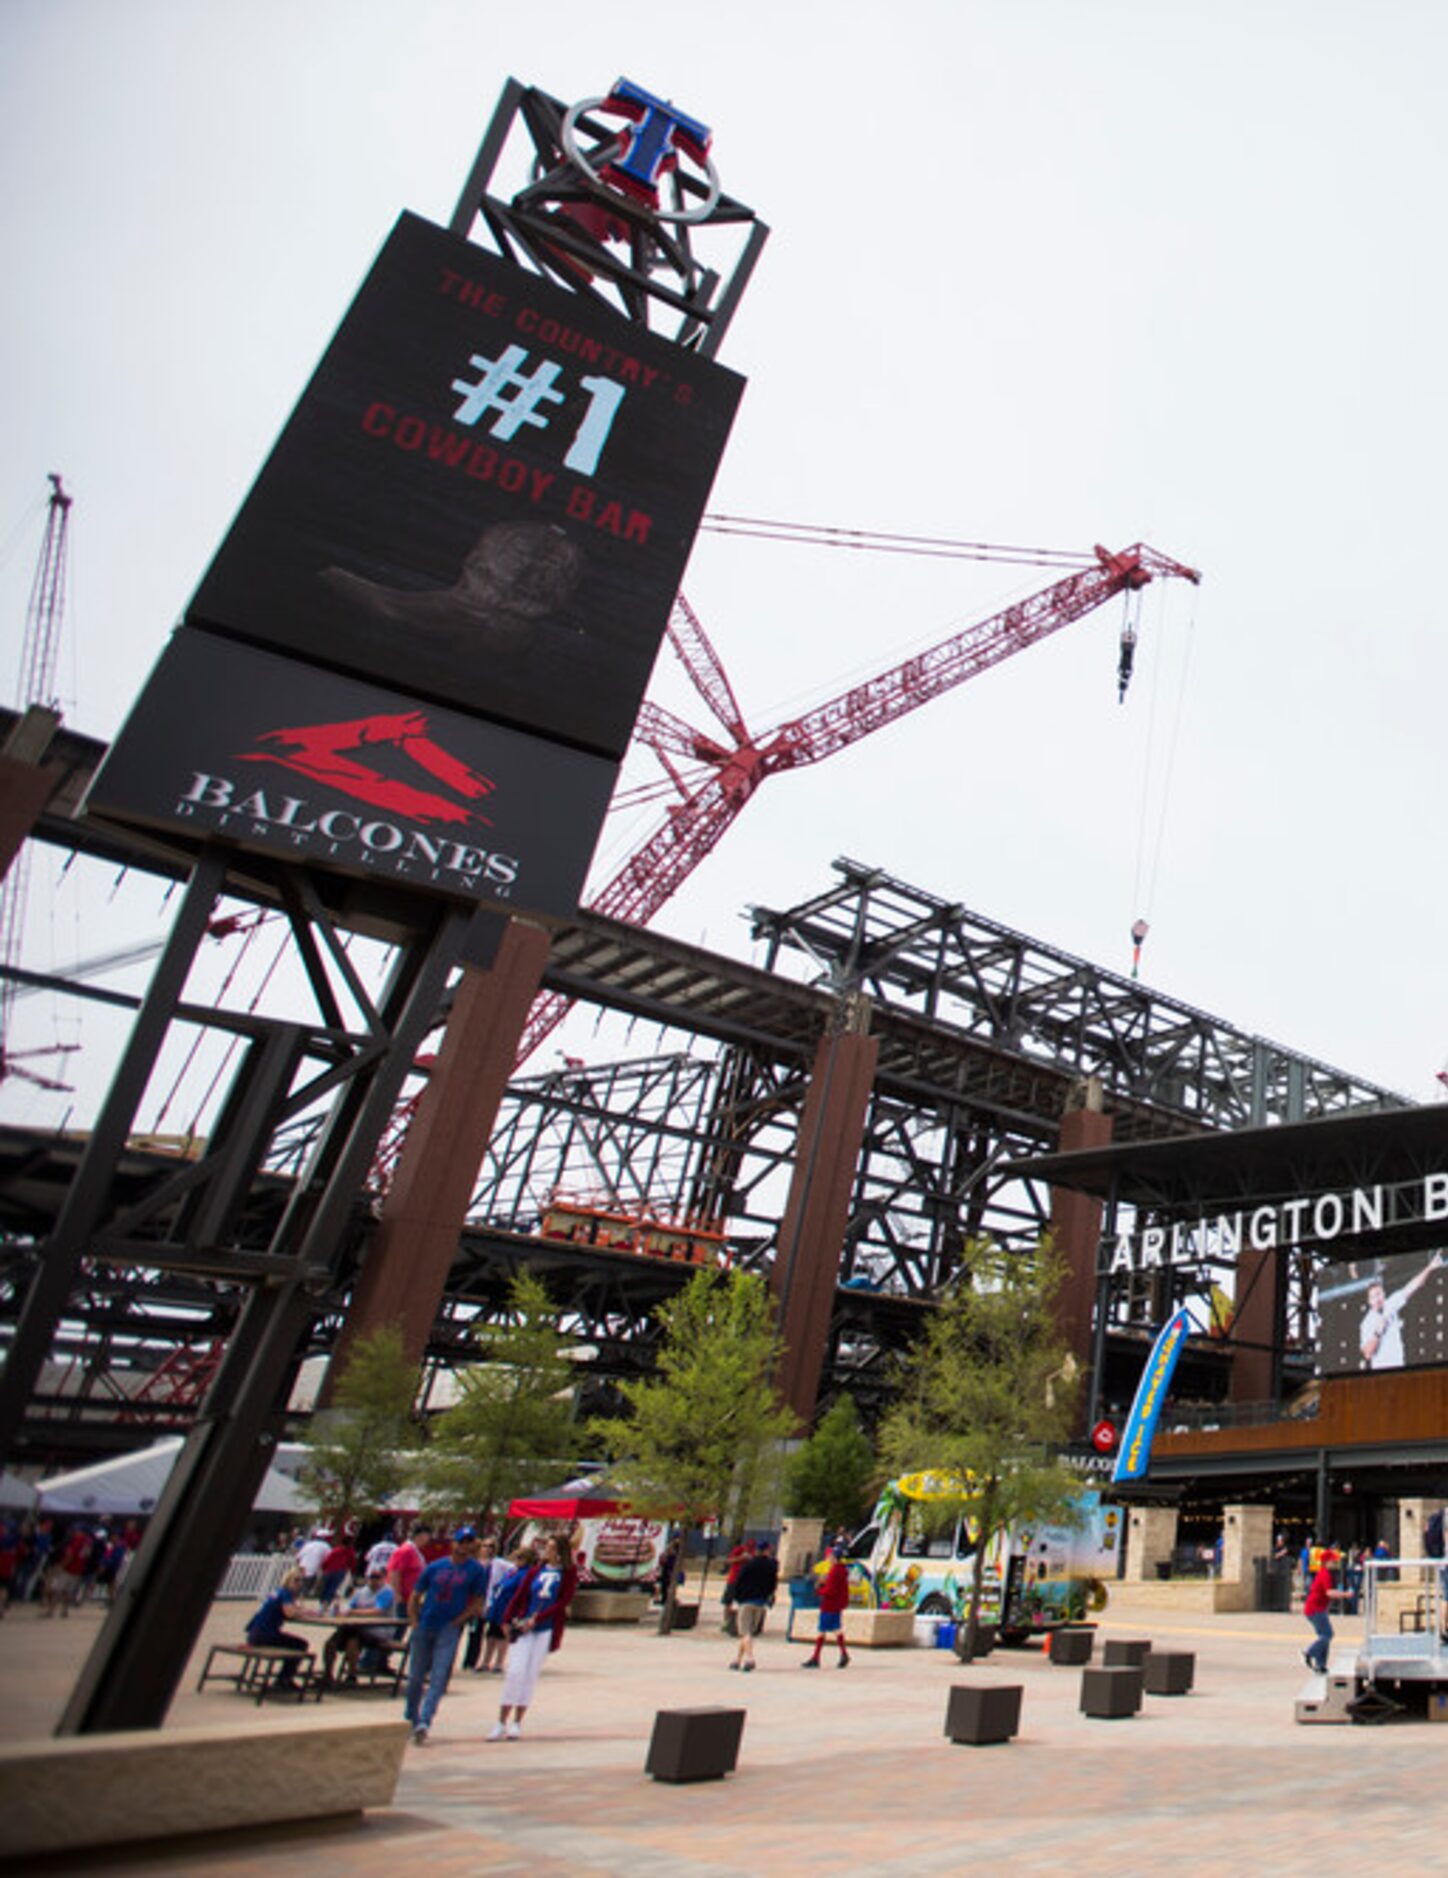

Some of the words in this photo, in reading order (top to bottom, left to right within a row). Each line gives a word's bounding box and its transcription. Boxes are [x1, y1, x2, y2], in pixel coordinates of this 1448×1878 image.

[438, 266, 508, 318] THE
[451, 343, 627, 477] #1
[361, 402, 557, 504] COWBOY
[564, 485, 655, 545] BAR
[175, 801, 512, 898] DISTILLING
[178, 771, 520, 885] BALCONES
[1110, 1185, 1384, 1274] ARLINGTON
[1126, 1424, 1147, 1473] ICE
[538, 1569, 561, 1598] T
